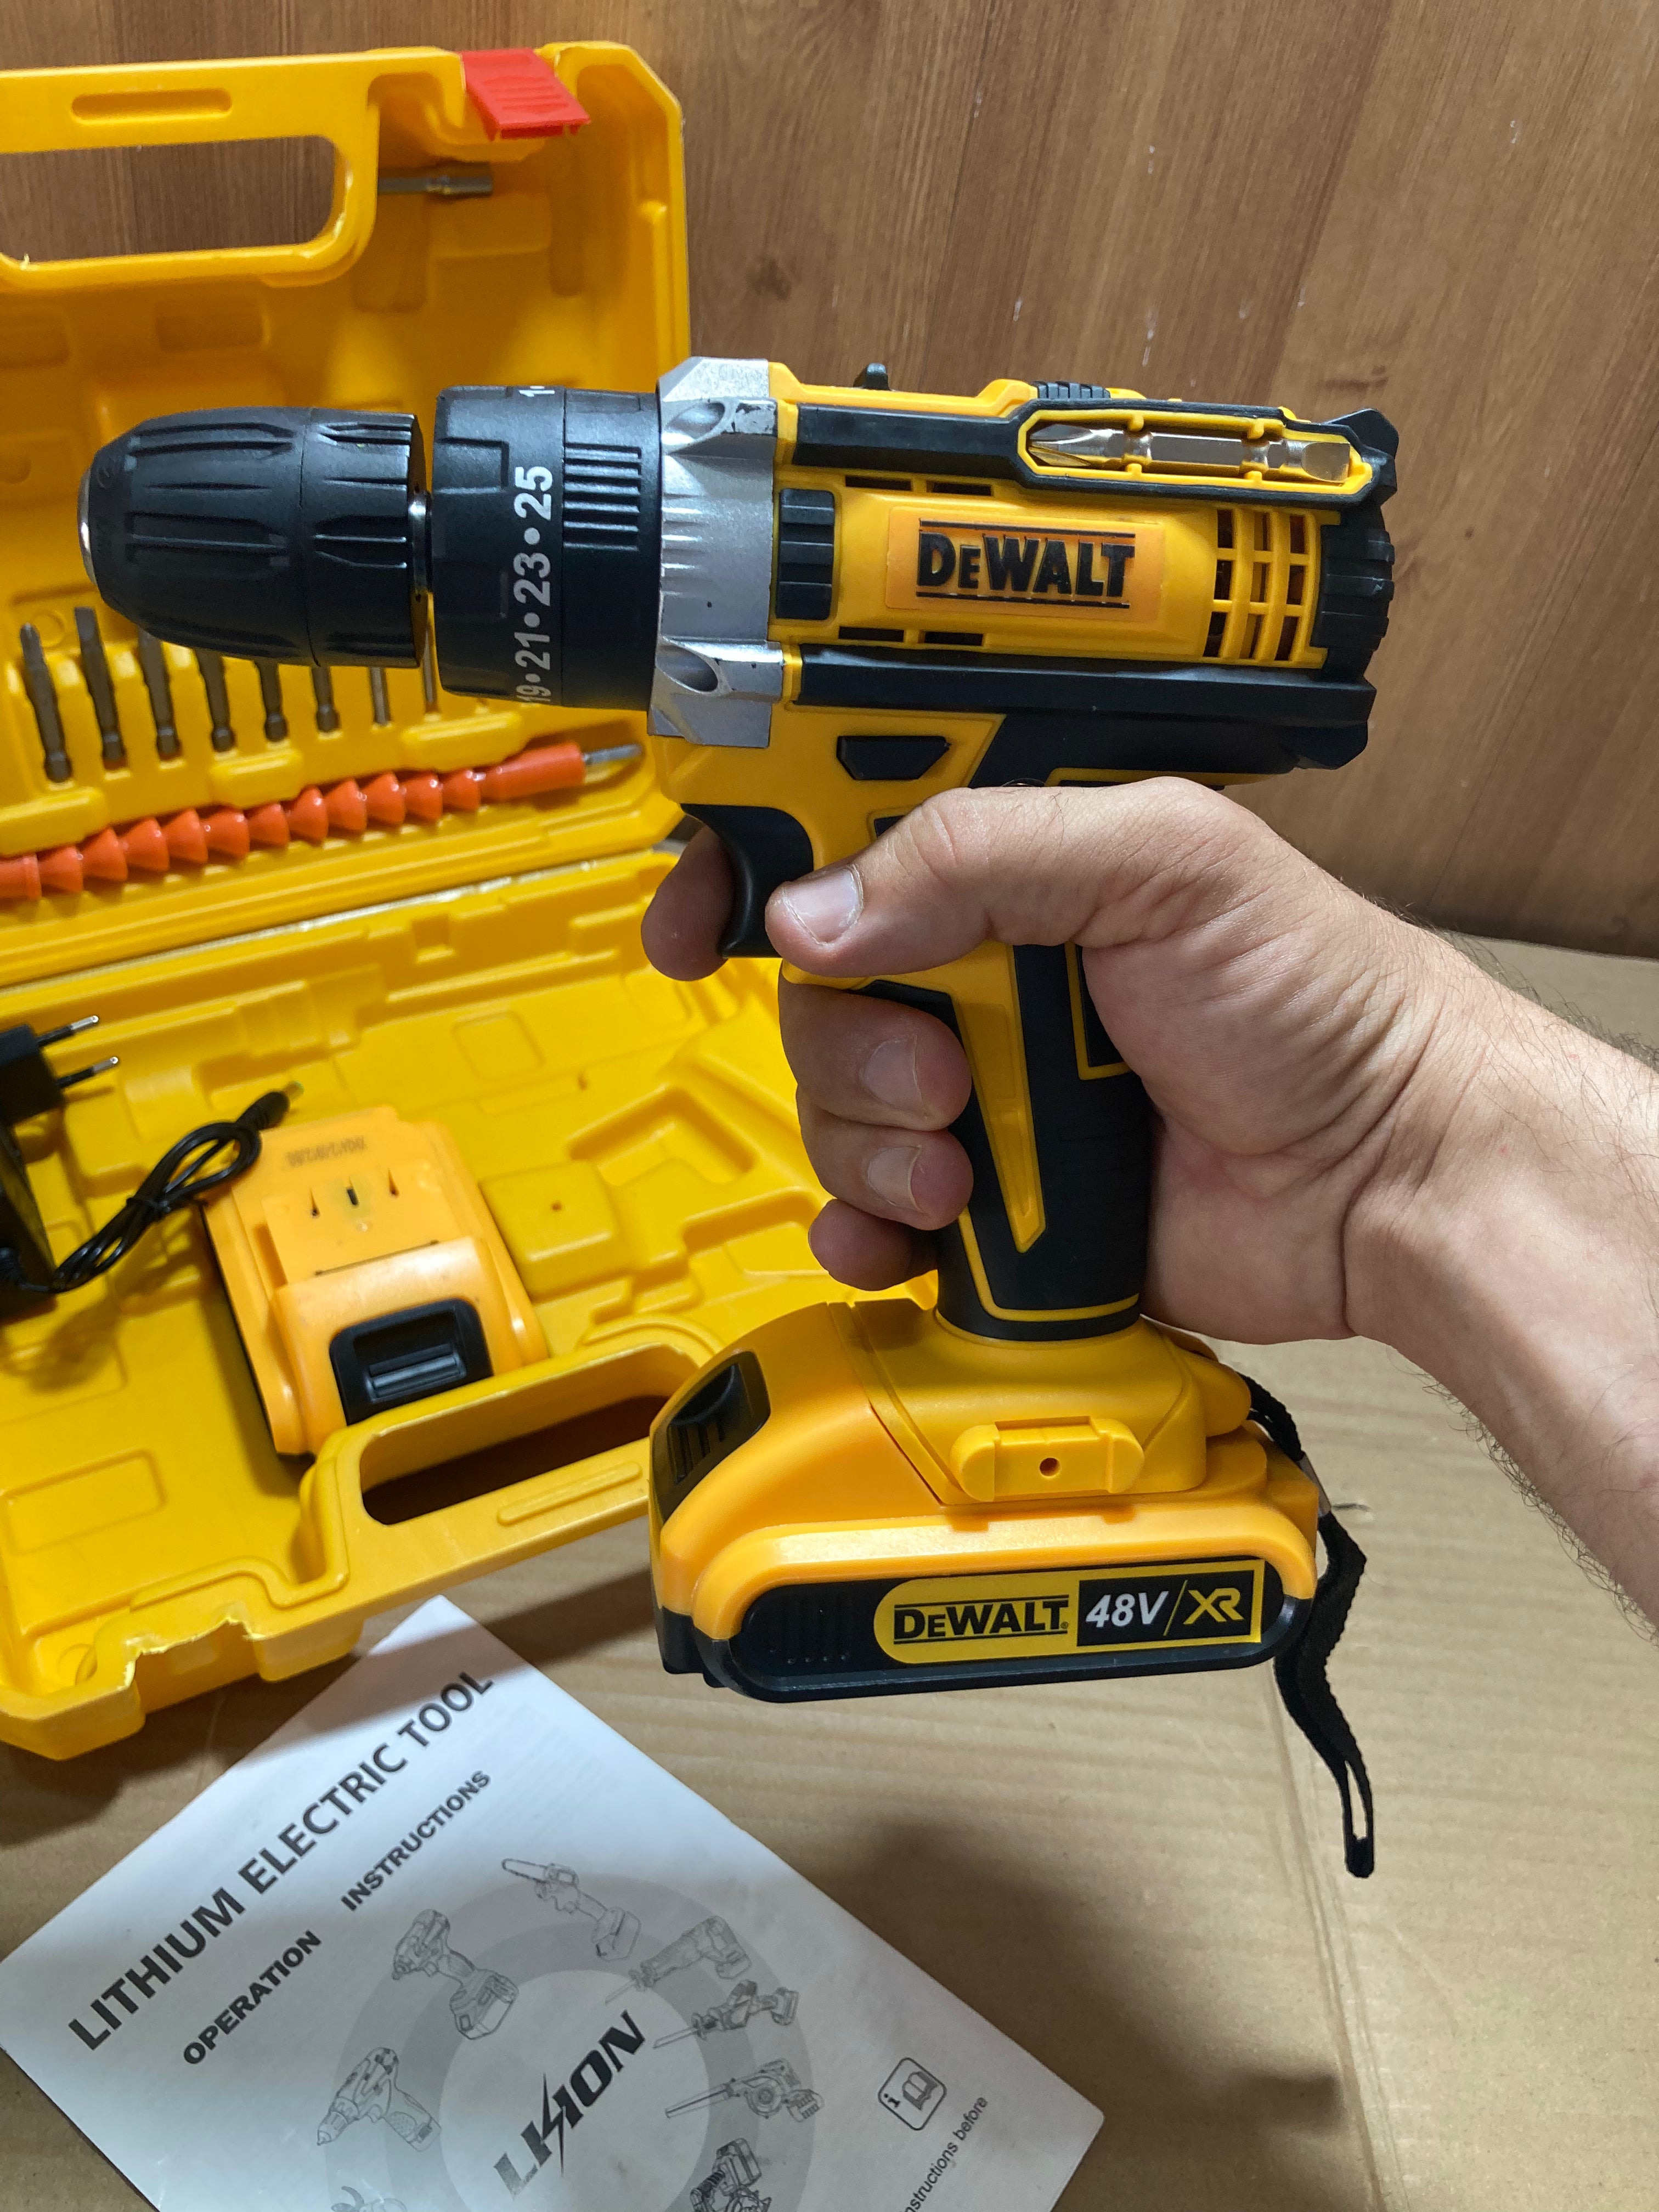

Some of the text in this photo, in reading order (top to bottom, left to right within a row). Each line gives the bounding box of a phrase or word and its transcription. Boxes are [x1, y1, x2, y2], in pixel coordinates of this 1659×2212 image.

[514, 466, 553, 521] 25
[514, 552, 551, 606] 23
[917, 531, 1136, 597] DEWALT
[515, 632, 550, 670] 21
[68, 1671, 494, 2051] LITHIUM ELECTRIC TOOL
[183, 1770, 491, 2065] OPERATION INSTRUCTIONS
[900, 2097, 989, 2212] nstructions before
